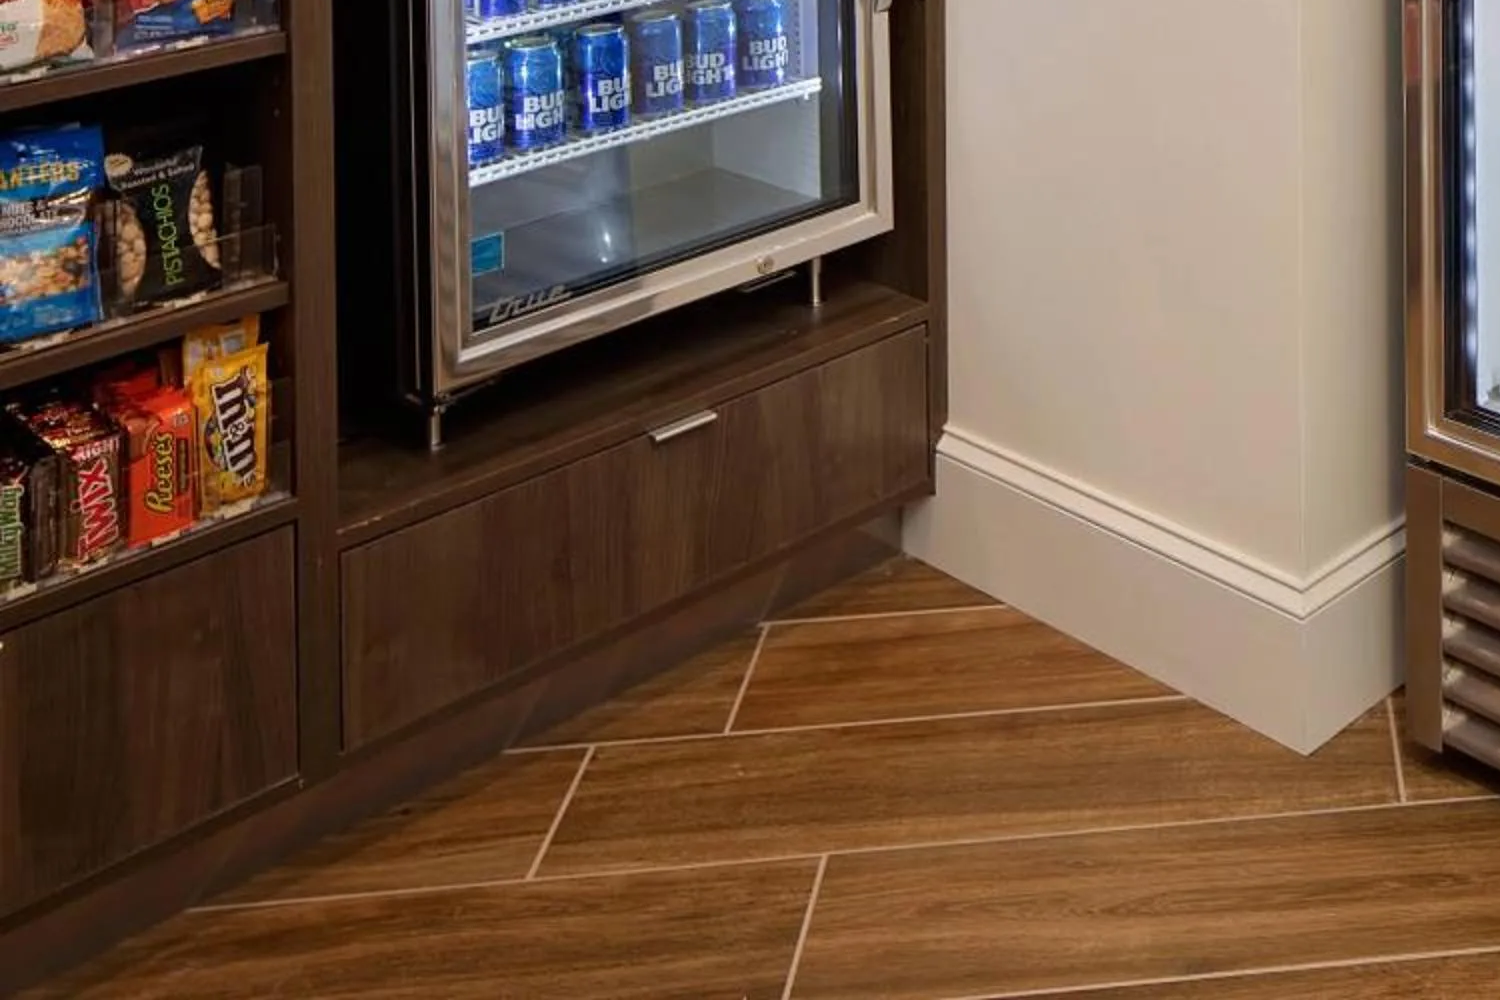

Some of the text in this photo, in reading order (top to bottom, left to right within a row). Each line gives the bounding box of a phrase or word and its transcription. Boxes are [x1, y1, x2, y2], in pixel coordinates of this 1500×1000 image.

[750, 36, 787, 55] BUD
[597, 75, 631, 96] BU
[469, 104, 504, 127] BU
[515, 107, 564, 130] LIGH
[152, 183, 185, 287] PISTACHIOS
